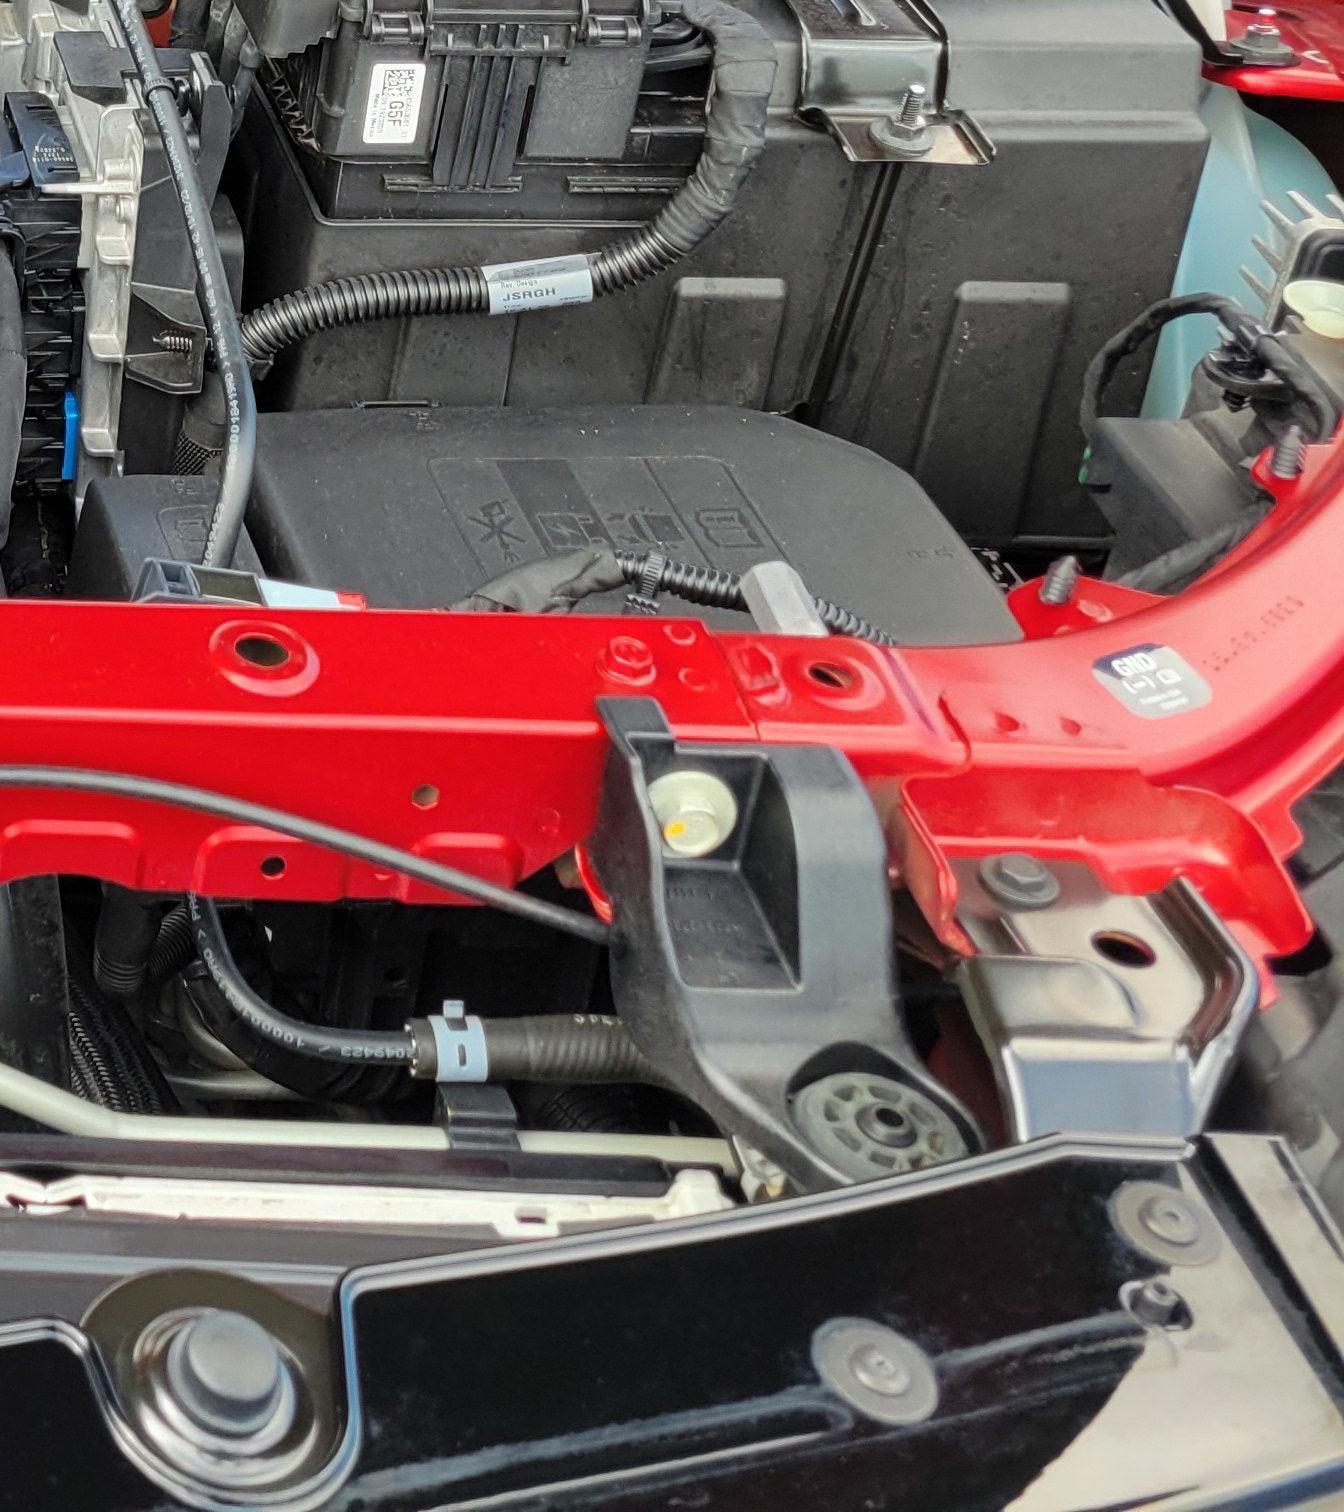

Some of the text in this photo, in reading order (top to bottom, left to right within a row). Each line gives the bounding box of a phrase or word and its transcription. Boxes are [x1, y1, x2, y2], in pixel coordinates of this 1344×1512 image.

[387, 101, 405, 127] G5F
[502, 287, 556, 302] JSRGH
[1111, 652, 1157, 677] GND
